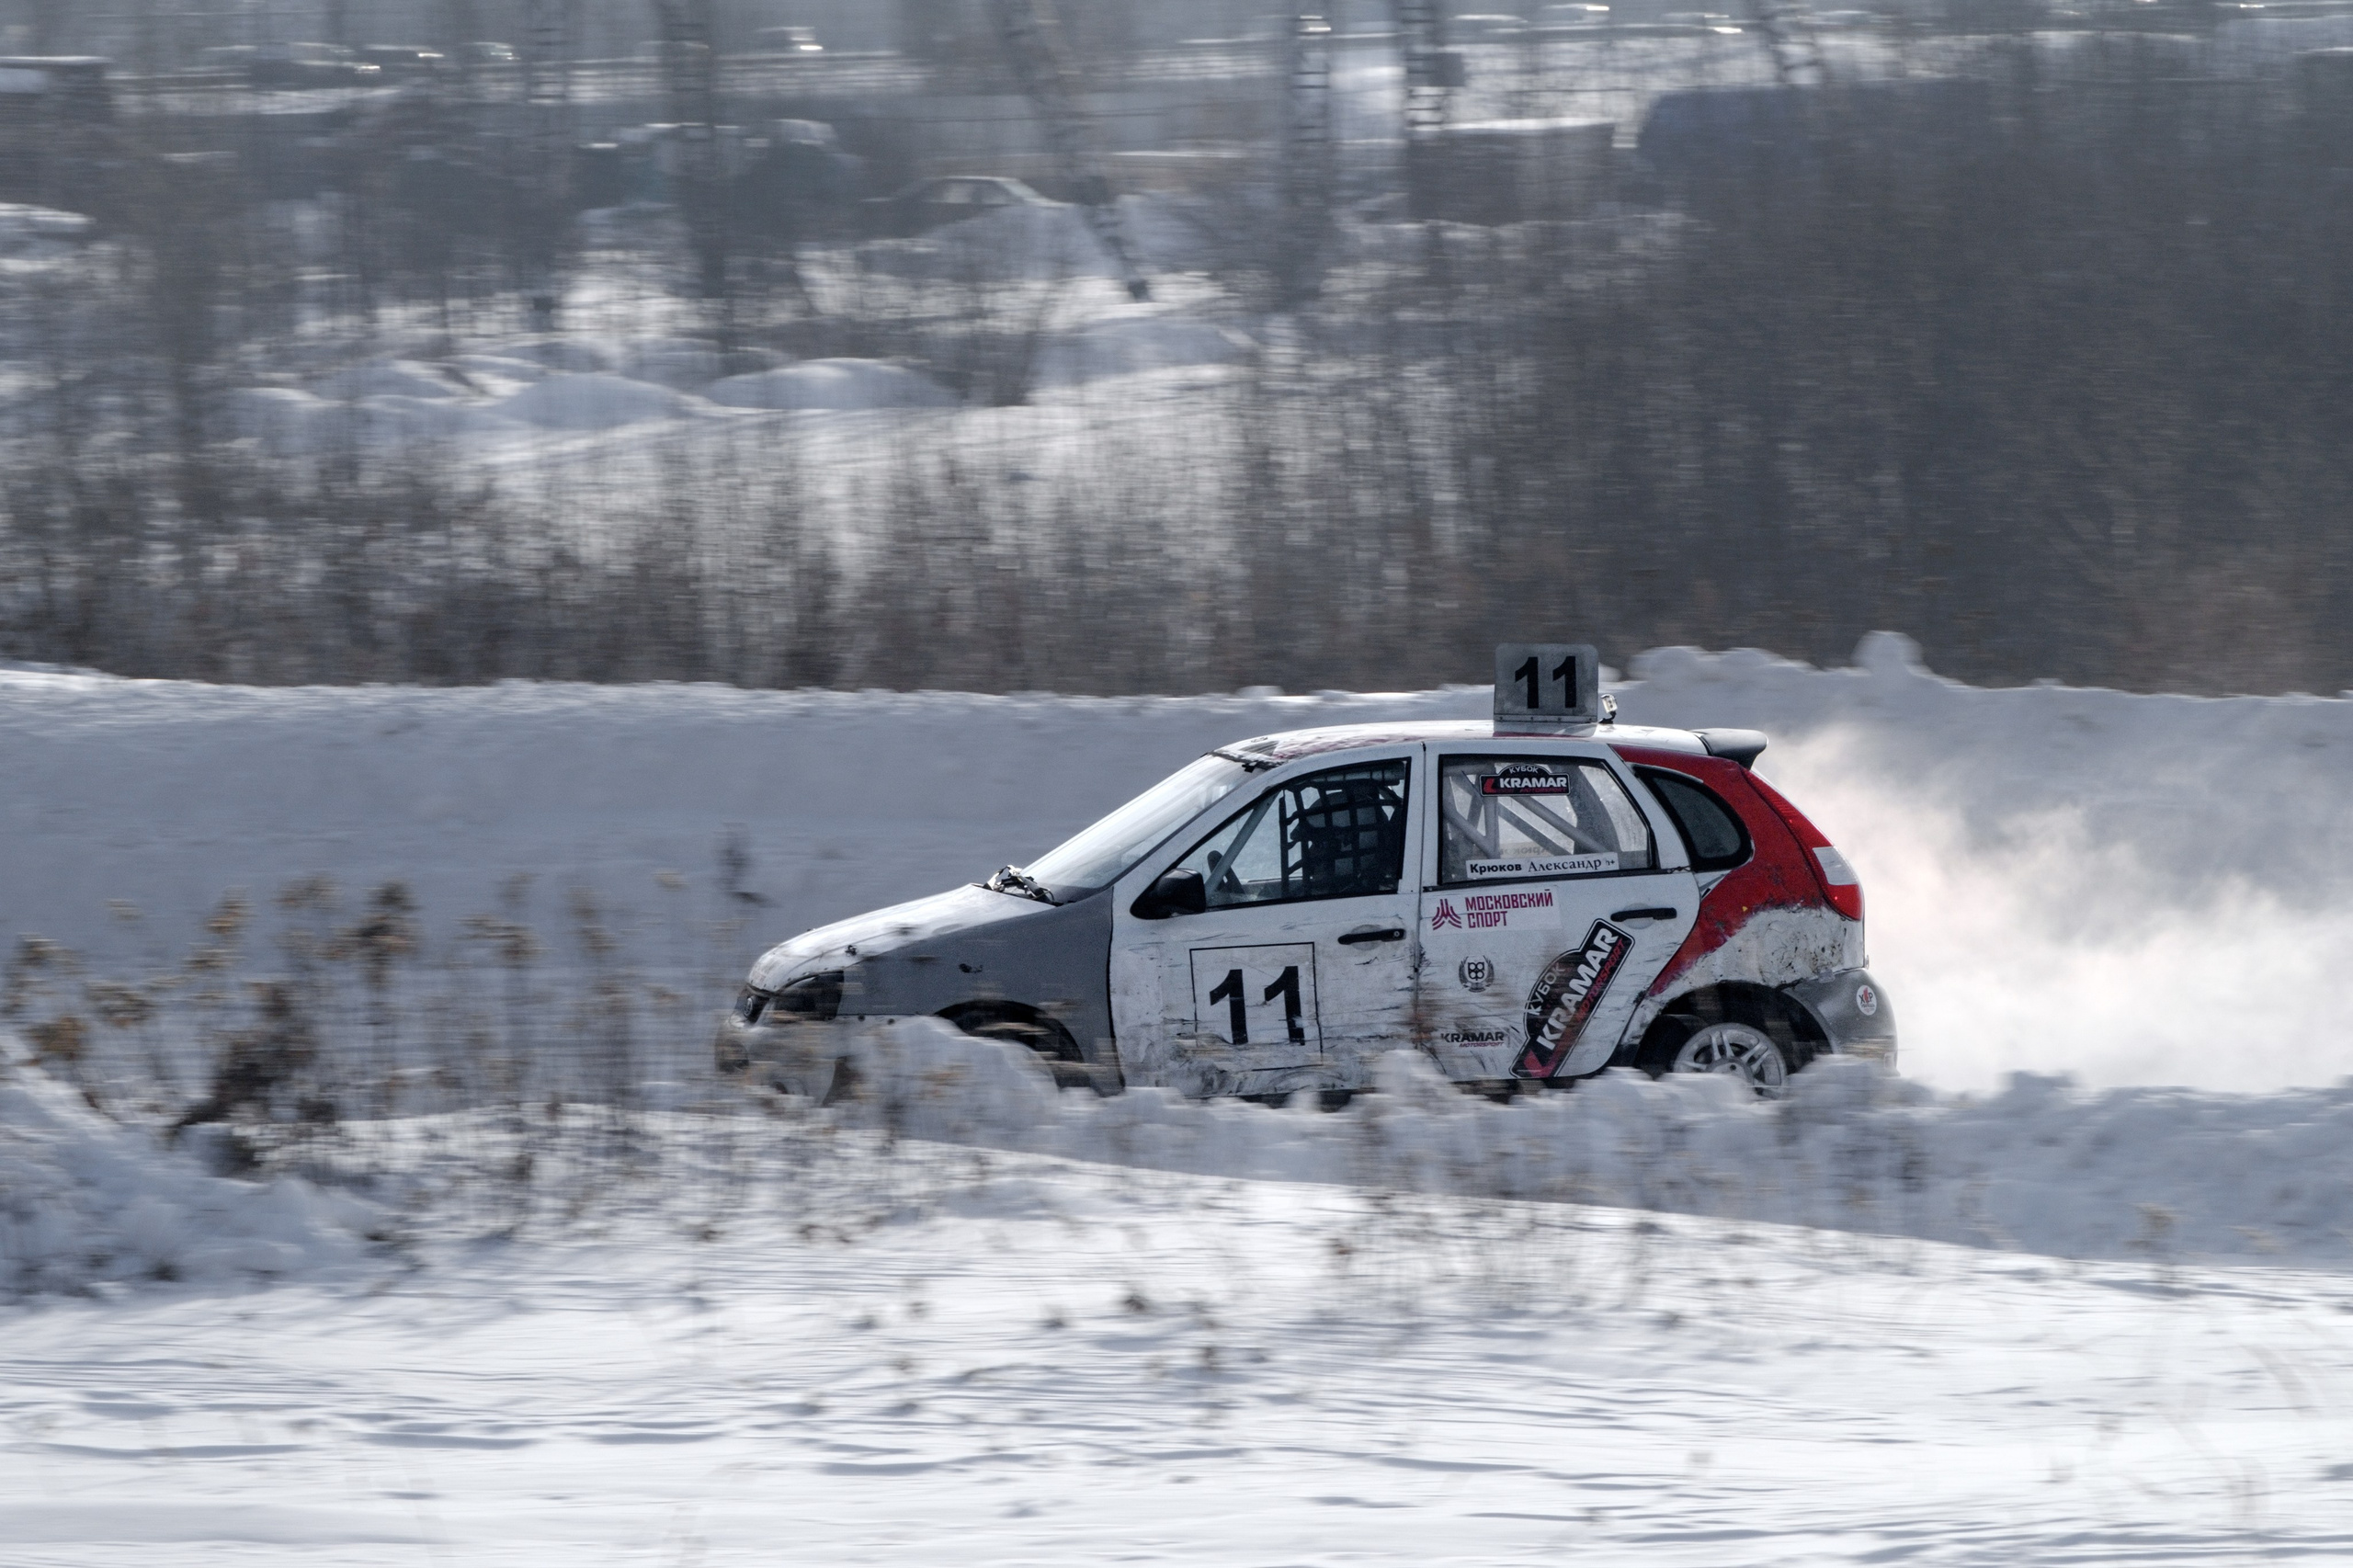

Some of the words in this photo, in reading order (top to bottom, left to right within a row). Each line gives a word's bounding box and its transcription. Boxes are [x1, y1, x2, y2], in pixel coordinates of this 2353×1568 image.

[1515, 655, 1576, 709] 11
[1508, 766, 1539, 774] КУБОК
[1499, 777, 1567, 788] KRAMAR
[1470, 863, 1522, 875] Крюков
[1528, 858, 1602, 872] Александр
[1464, 889, 1553, 911] МОСКОВСКИЙ
[1467, 911, 1507, 928] СПОРТ
[1529, 962, 1565, 1016] КУБОК
[1536, 927, 1619, 1051] KRAMAR
[1575, 937, 1625, 1023] MOTORSPORT
[1209, 965, 1305, 1046] 11
[1440, 1031, 1505, 1042] KRAMAR
